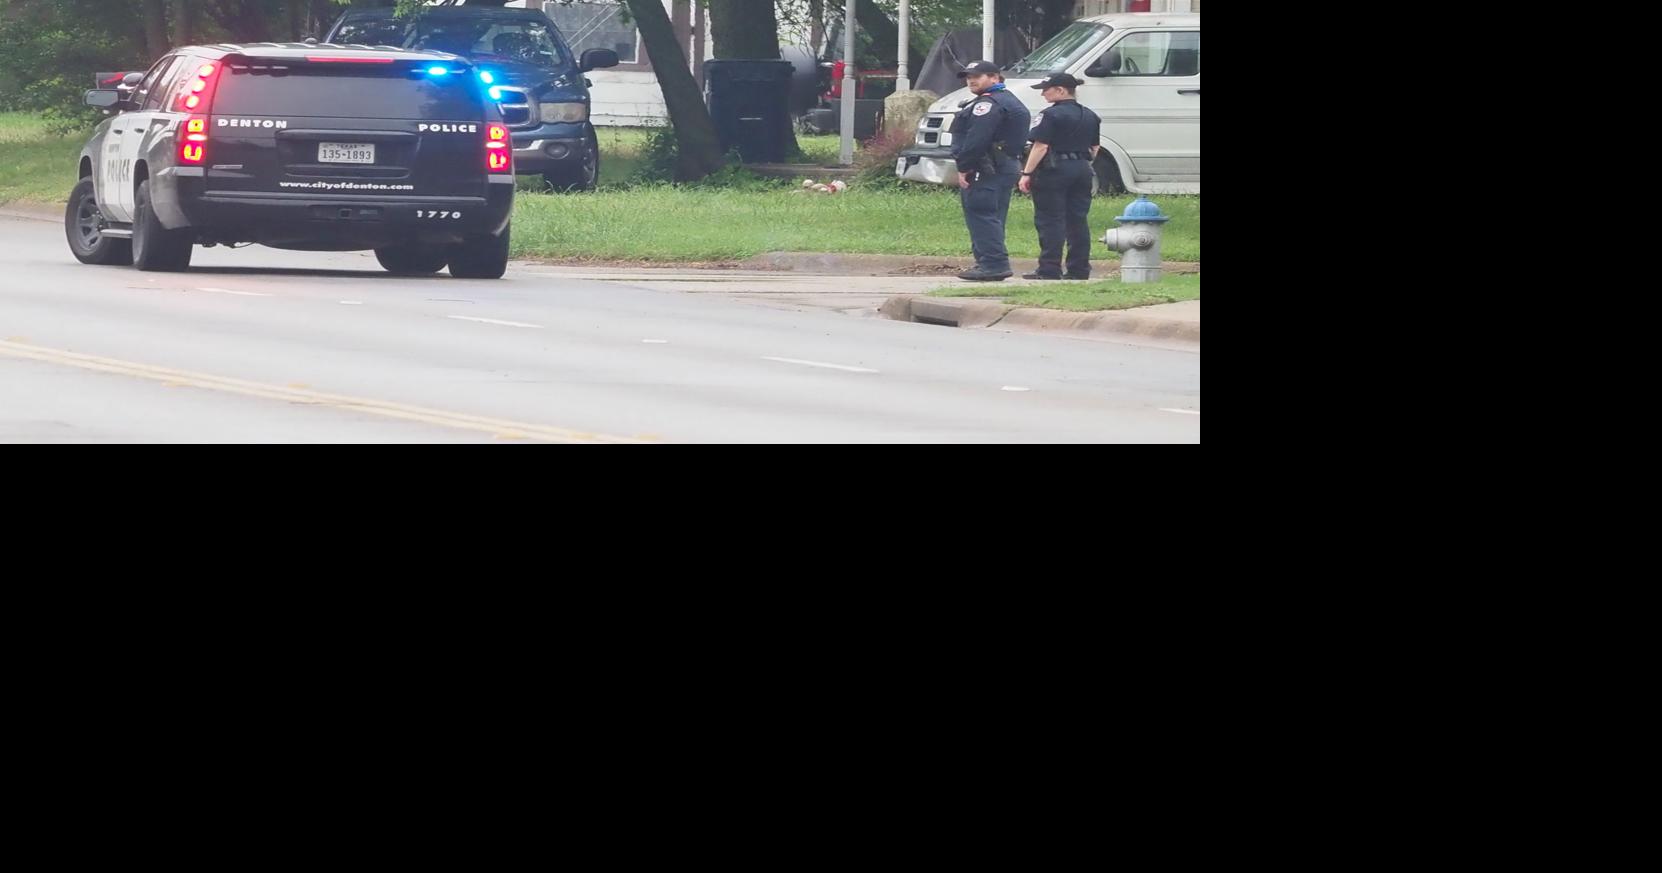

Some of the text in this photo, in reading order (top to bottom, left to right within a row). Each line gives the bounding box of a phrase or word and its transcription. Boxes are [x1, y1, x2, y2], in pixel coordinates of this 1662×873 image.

[217, 118, 287, 129] DENTON
[418, 123, 478, 133] POLICE
[322, 149, 372, 160] 135-1893
[279, 181, 414, 190] www.cityofdenton.com
[416, 210, 462, 219] 1770
